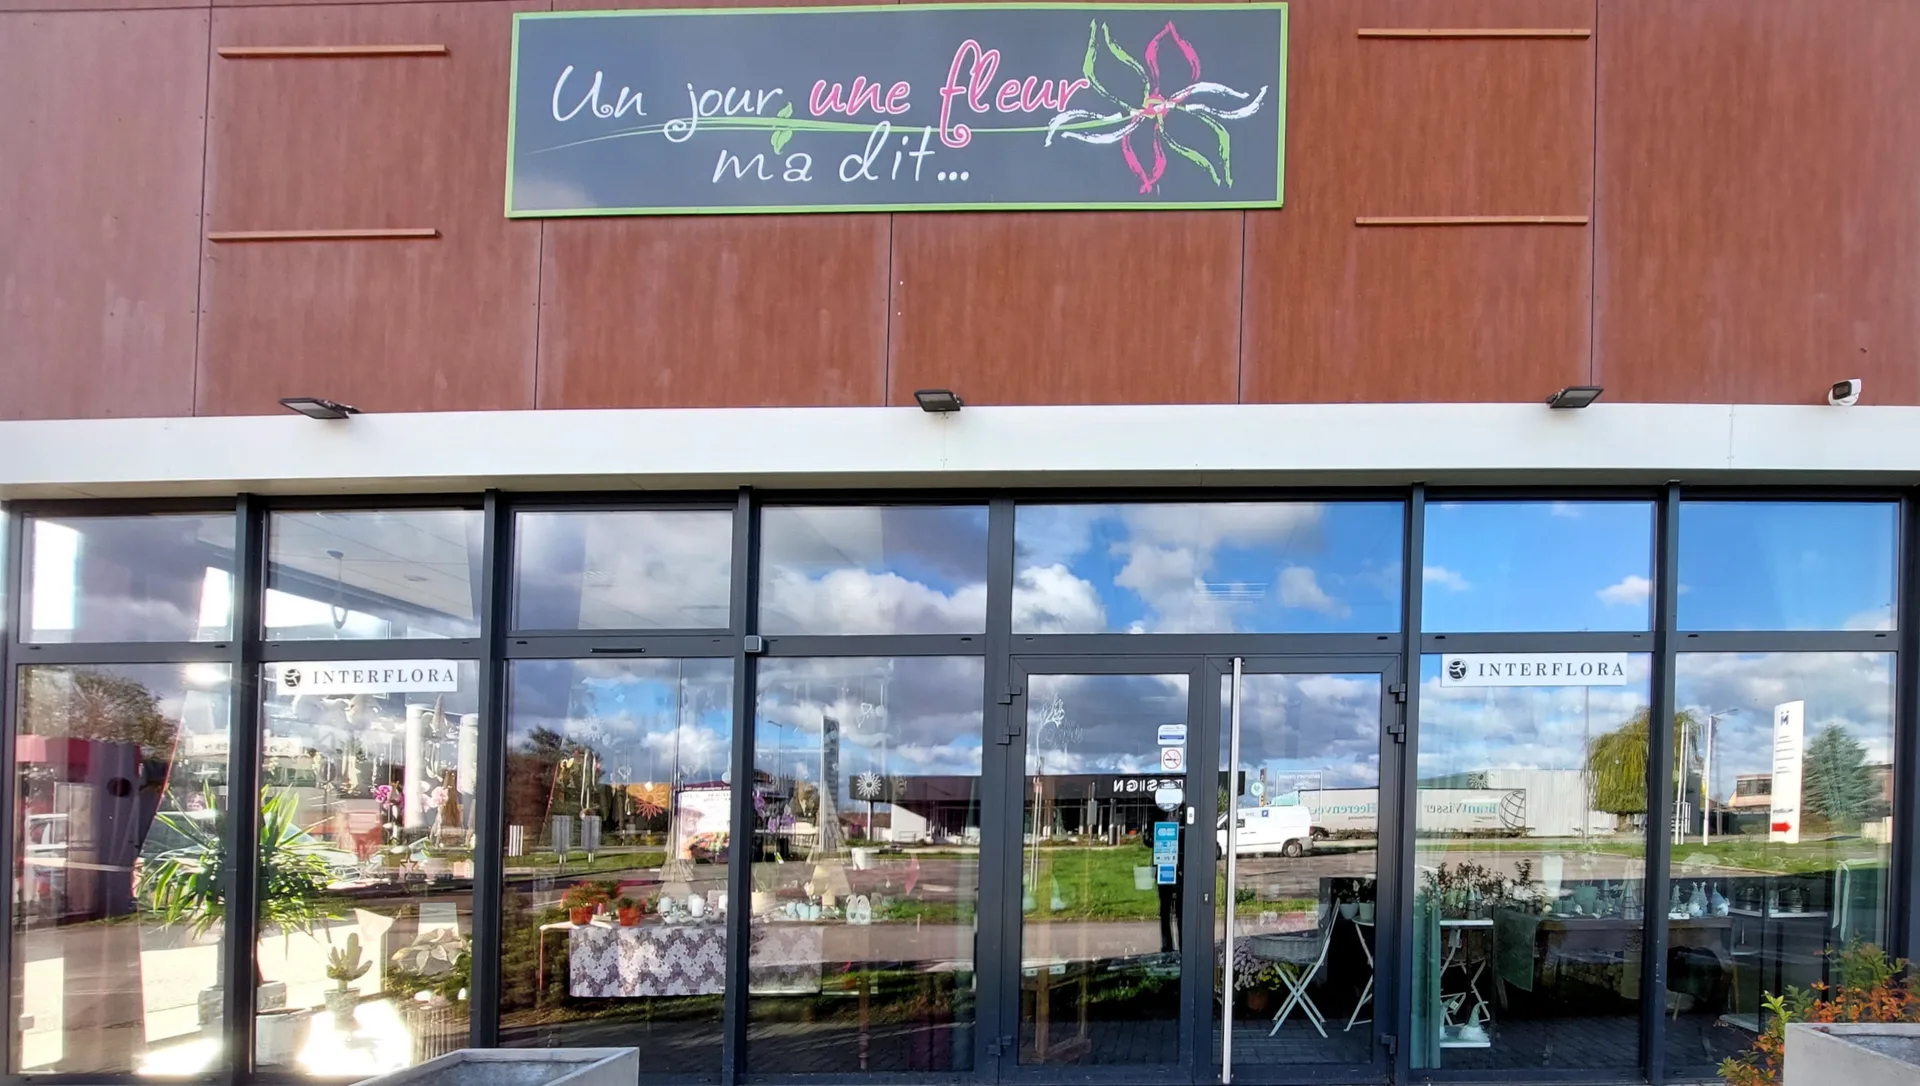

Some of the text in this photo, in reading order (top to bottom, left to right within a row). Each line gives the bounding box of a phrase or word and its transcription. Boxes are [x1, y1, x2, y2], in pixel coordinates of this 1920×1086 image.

[552, 39, 1090, 148] Un jour une fleur
[838, 121, 969, 182] dit...
[313, 668, 455, 684] INTERFLORA
[1479, 662, 1625, 676] INTERFLORA
